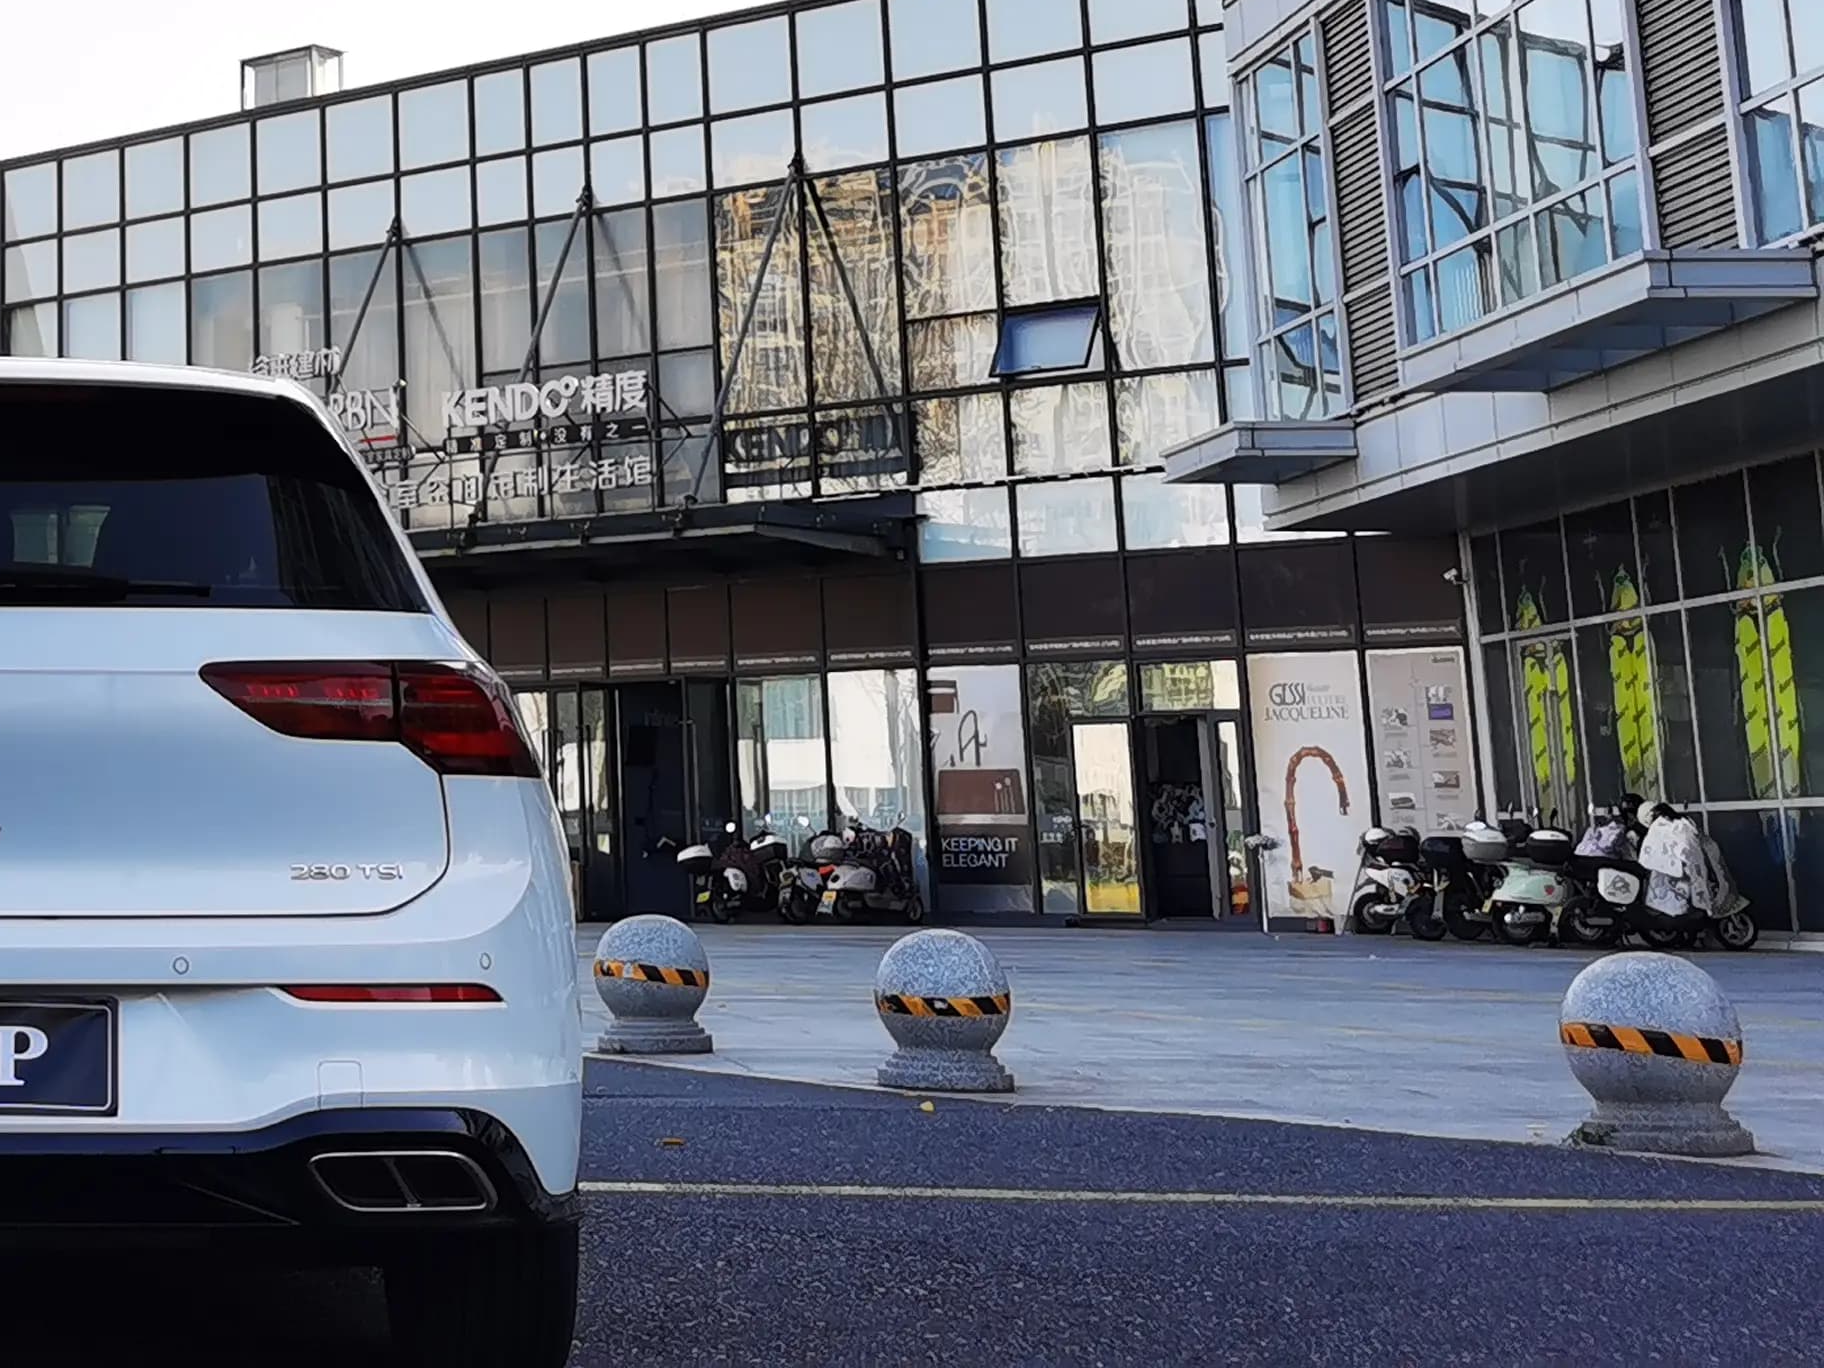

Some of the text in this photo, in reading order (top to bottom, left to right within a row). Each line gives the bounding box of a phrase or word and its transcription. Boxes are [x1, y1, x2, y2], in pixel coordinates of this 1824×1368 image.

[581, 370, 649, 415] 精度
[941, 837, 1019, 852] KEEPING IT
[942, 853, 1008, 868] ELEGANT
[290, 863, 404, 881] 280 TSI
